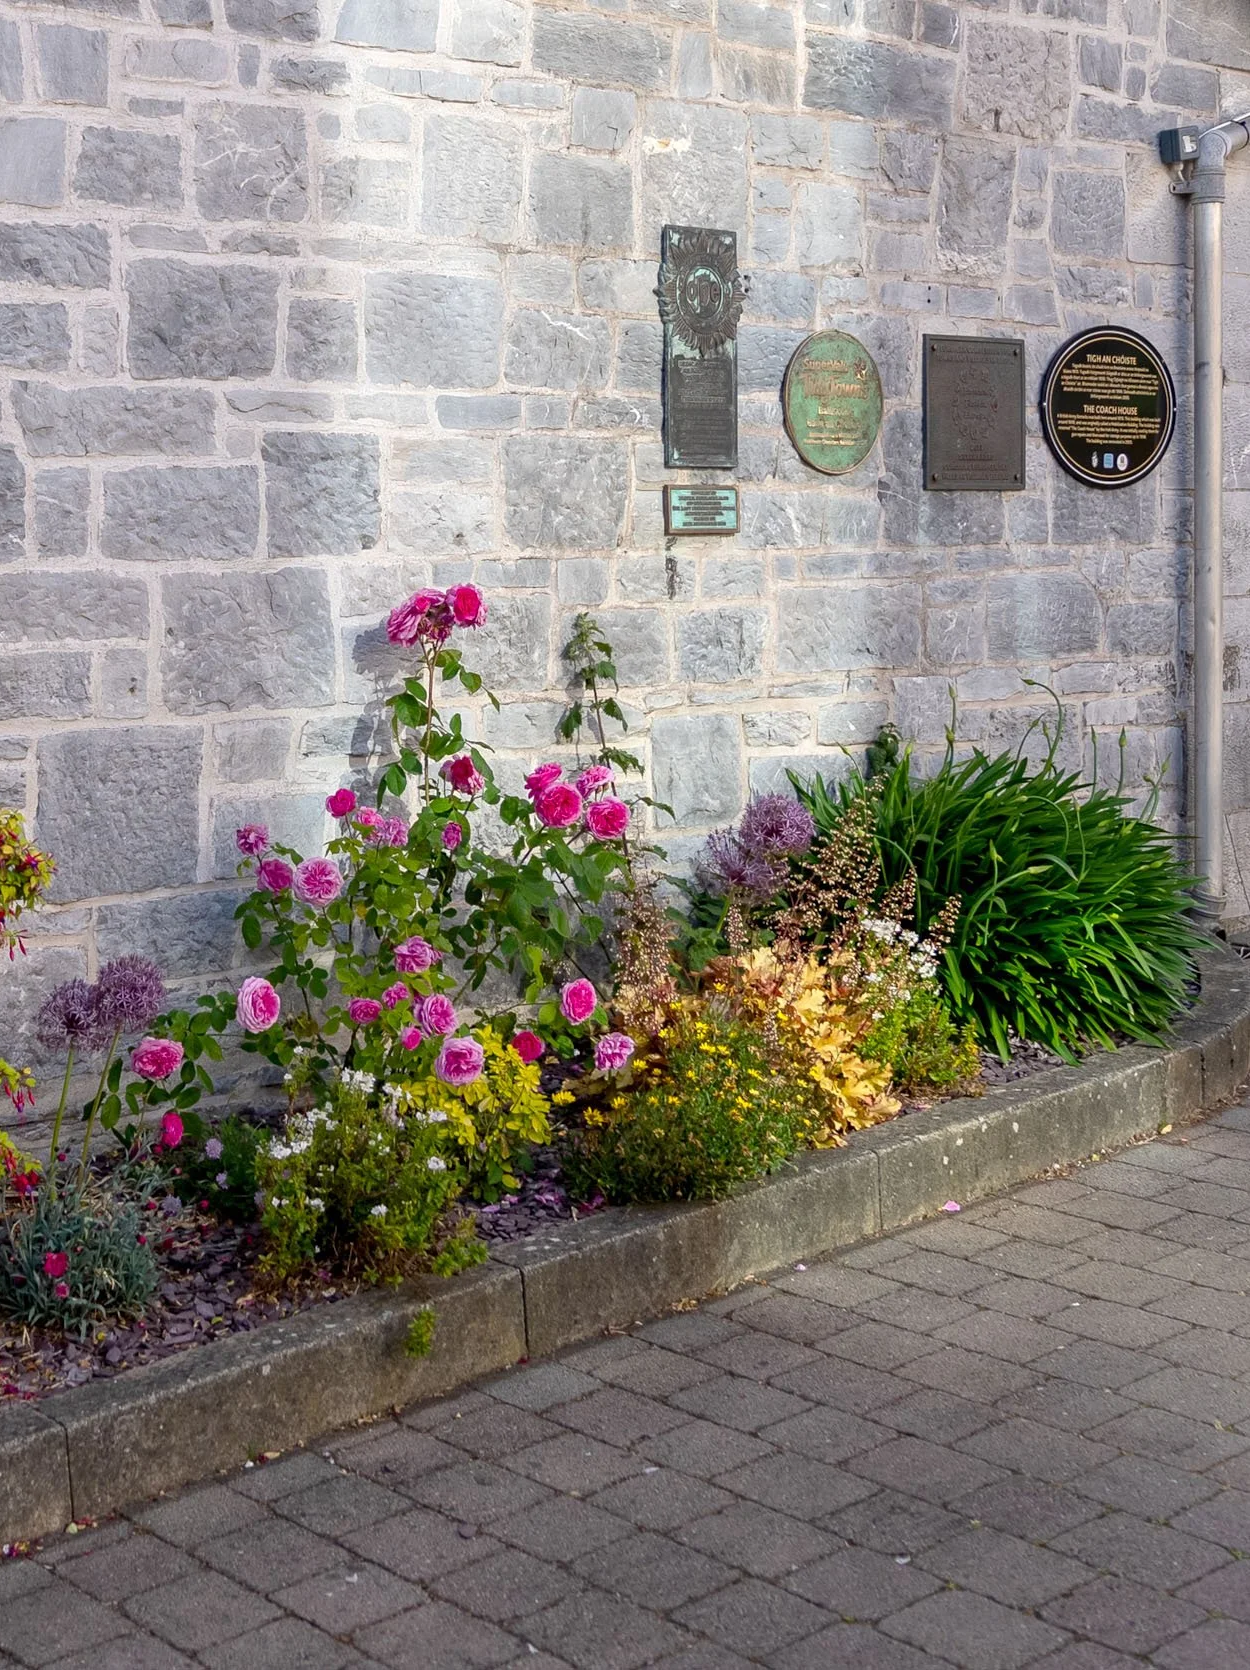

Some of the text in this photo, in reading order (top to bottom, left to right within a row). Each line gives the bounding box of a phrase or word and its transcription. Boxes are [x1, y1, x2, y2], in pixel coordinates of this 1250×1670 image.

[1086, 354, 1101, 363] TIGH
[1101, 355, 1111, 363] AN
[1083, 404, 1138, 415] THE COACH HOUSE
